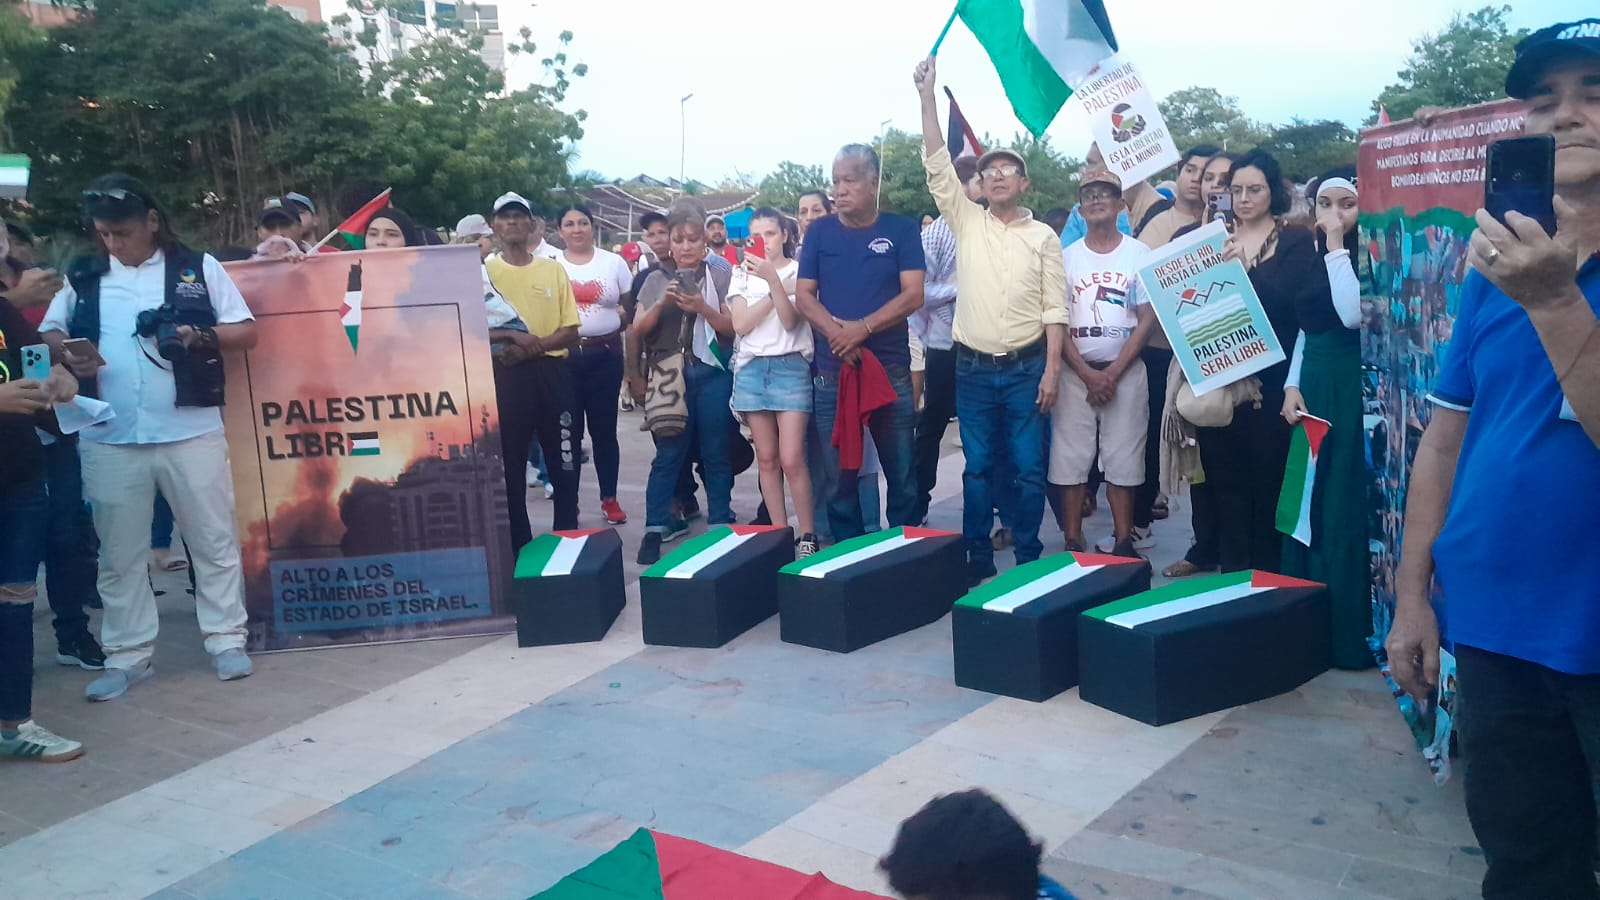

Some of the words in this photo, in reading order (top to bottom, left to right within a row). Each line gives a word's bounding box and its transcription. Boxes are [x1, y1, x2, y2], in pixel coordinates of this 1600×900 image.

[1075, 89, 1089, 100] LA
[1087, 69, 1121, 94] LIBERTAD
[1121, 62, 1135, 77] DE
[1083, 75, 1143, 115] PALESTINA
[1420, 129, 1430, 143] LA
[1431, 123, 1475, 142] HUMANIDAD
[1476, 118, 1509, 136] CUANDO
[1109, 151, 1119, 164] ES
[1119, 146, 1131, 159] LA
[1129, 128, 1164, 152] LIBERTAD
[1121, 158, 1137, 172] DEL
[1135, 143, 1163, 164] MUNDO
[1420, 150, 1437, 165] PARA
[1465, 146, 1476, 160] AL
[1450, 169, 1462, 183] NO
[1461, 164, 1480, 183] ESTÁ
[1154, 257, 1184, 278] DESDE
[1184, 251, 1198, 266] EL
[1159, 269, 1191, 290] HASTA
[1191, 261, 1206, 276] EL
[1204, 252, 1225, 269] MAR
[1193, 324, 1258, 362] PALESTINA
[1233, 338, 1269, 364] LIBRE
[261, 391, 458, 427] PALESTINA
[280, 566, 331, 585] ALTO
[335, 565, 350, 583] A
[352, 562, 395, 581] LOS
[281, 582, 388, 604] CRÍMENES
[392, 579, 430, 596] DEL
[282, 602, 362, 624] ESTADO
[366, 600, 393, 617] DE
[397, 595, 479, 616] ISRAEL.
